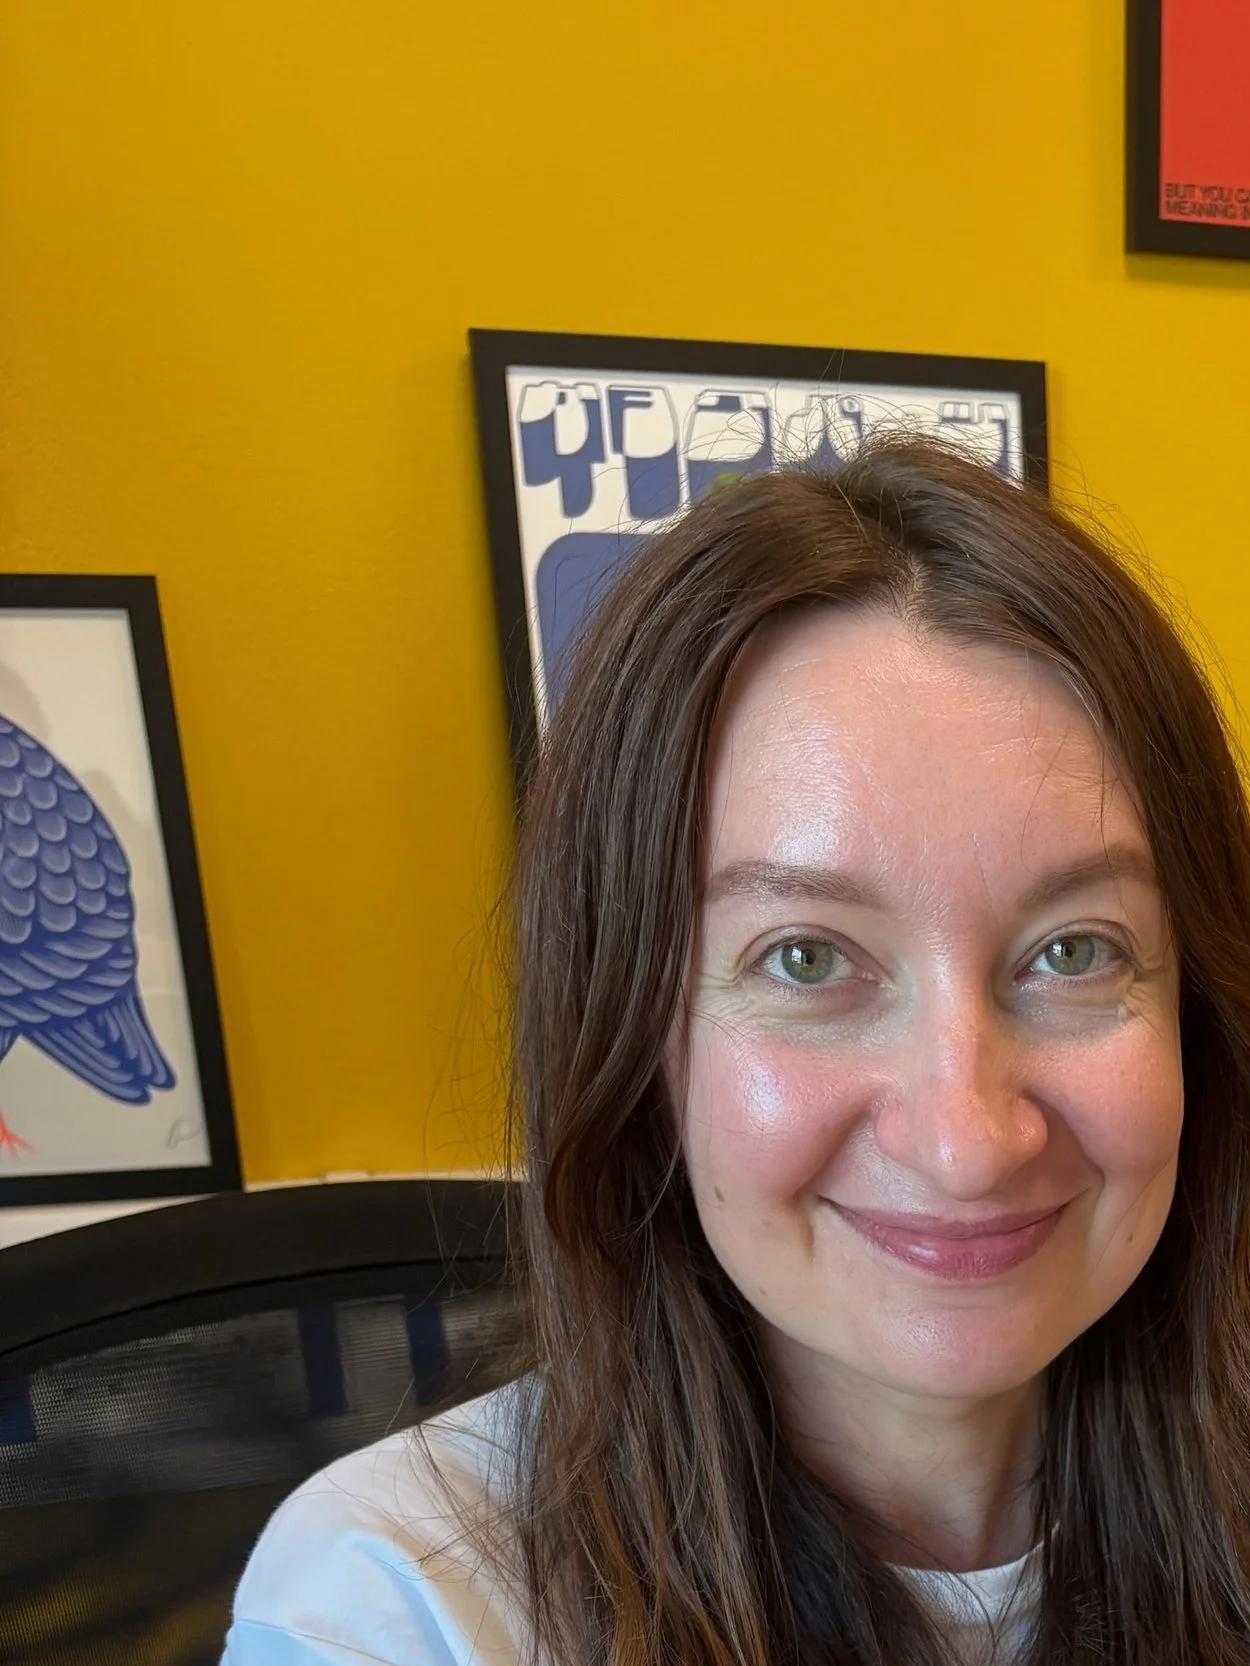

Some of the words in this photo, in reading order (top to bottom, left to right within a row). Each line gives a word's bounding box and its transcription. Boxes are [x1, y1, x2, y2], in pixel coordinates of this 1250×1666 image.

[1165, 182, 1196, 200] BUT
[1202, 185, 1231, 203] YOU
[1165, 200, 1237, 220] MEANING
